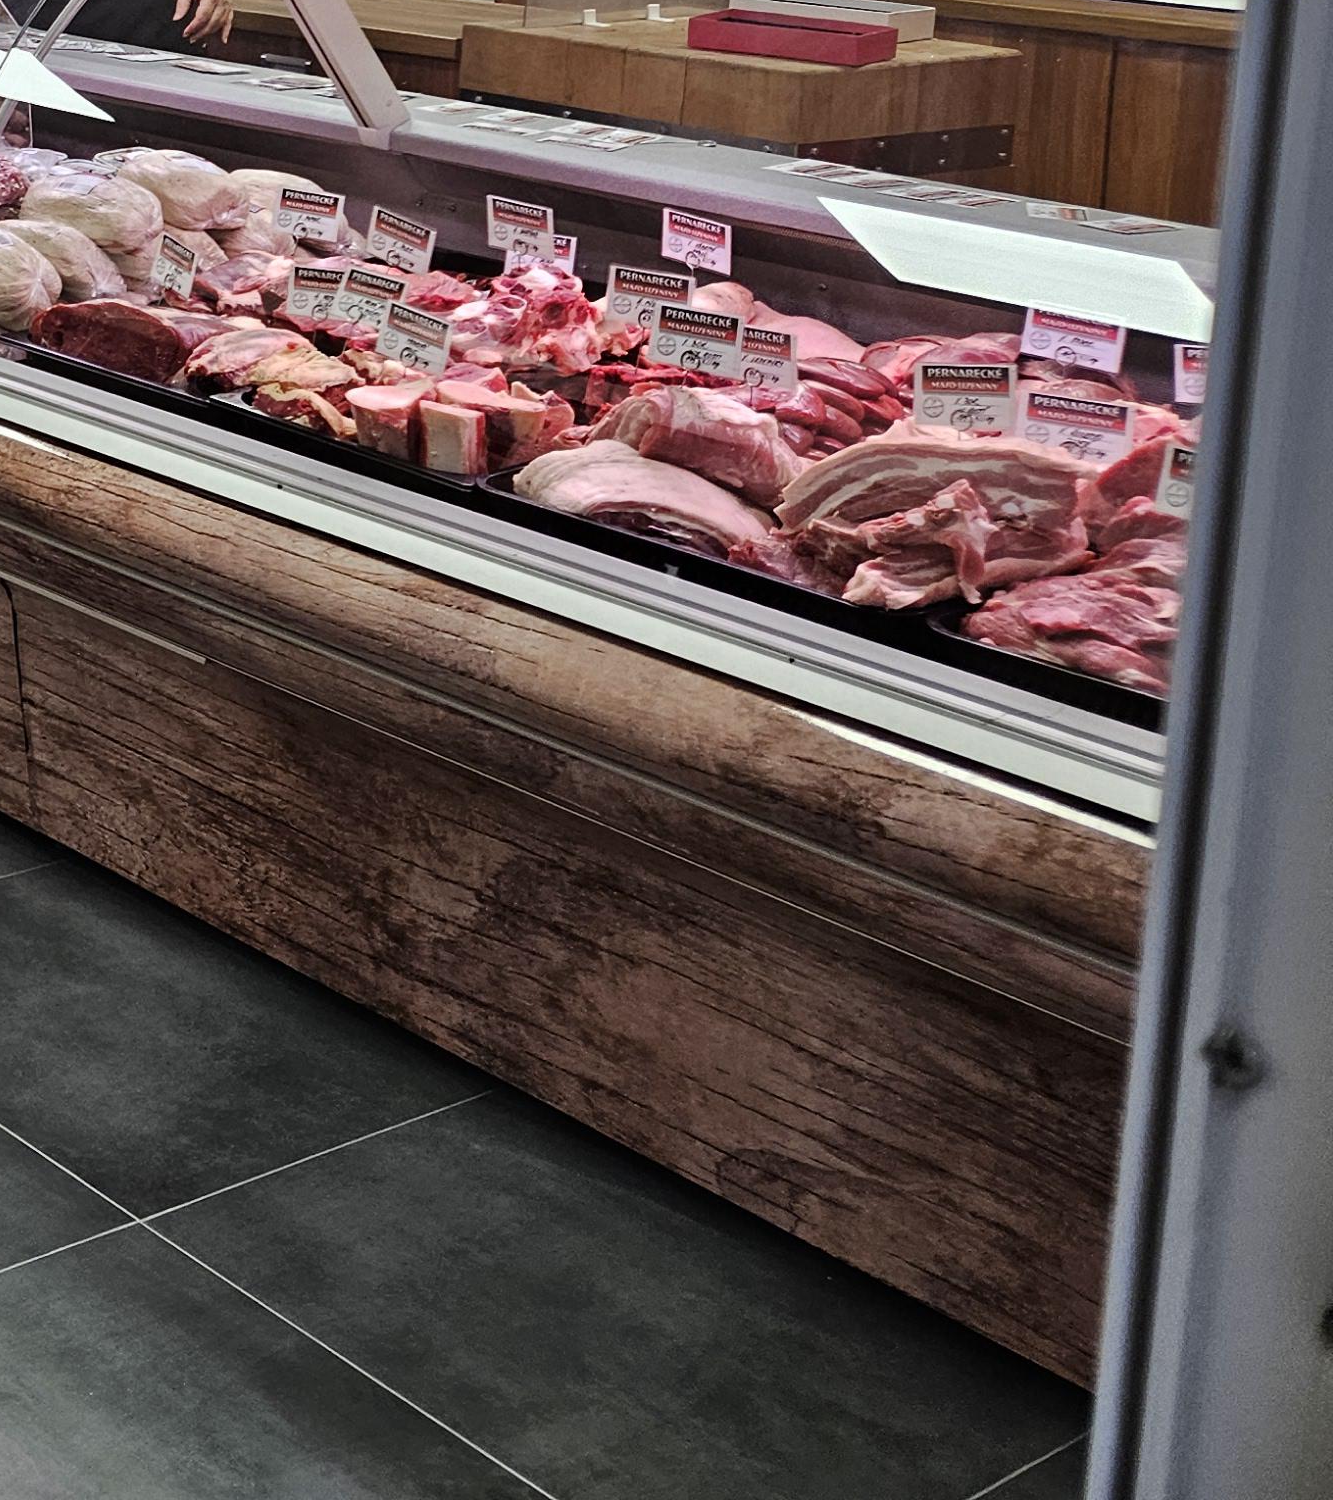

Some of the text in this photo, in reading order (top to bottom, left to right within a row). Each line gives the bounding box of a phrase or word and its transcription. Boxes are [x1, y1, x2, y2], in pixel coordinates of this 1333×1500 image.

[619, 270, 684, 290] PERNARECKÉ
[665, 308, 733, 329] PERNARECKÉ
[744, 328, 786, 344] ARECKÉ
[926, 368, 1003, 380] PERNARECKÉ
[1034, 396, 1121, 417] PERNARECKÉ
